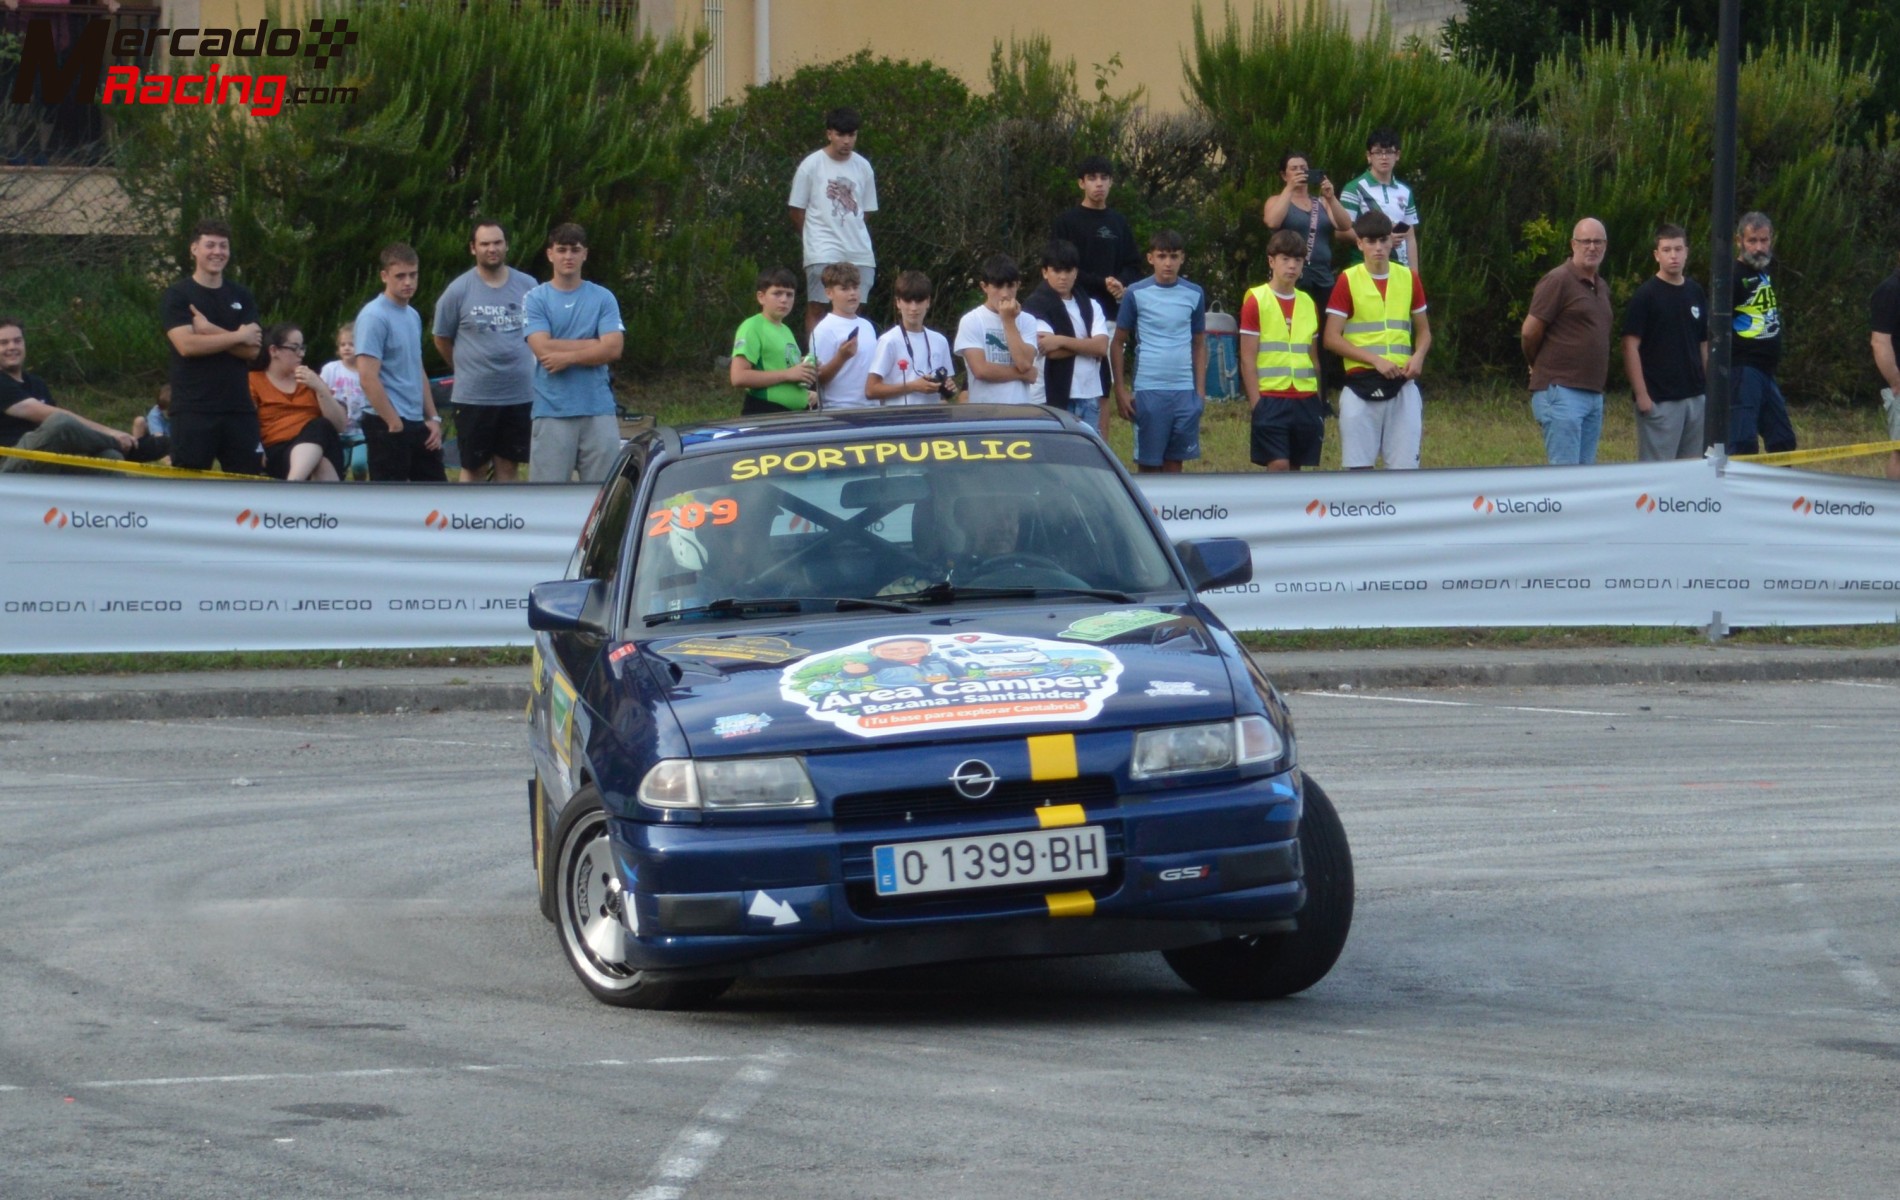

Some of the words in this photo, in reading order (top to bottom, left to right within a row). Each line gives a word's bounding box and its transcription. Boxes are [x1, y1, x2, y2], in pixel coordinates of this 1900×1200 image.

[730, 440, 1032, 480] SPORTPUBLIC
[1161, 504, 1228, 520] blendio
[1329, 501, 1396, 517] blendio
[1495, 498, 1562, 513] blendio
[1659, 497, 1722, 513] blendio
[1813, 500, 1875, 516] blendio
[72, 511, 148, 529] blendio
[264, 512, 339, 530] blendio
[451, 513, 525, 531] blendio
[648, 498, 738, 537] 209
[1275, 582, 1346, 593] OMODA
[1356, 579, 1428, 591] JAECOO
[1441, 579, 1511, 590] OMODA
[1520, 578, 1591, 590] JAECOO
[1604, 578, 1673, 589] OMODA
[1682, 578, 1750, 590] JAECOO
[1763, 579, 1829, 590] OMODA
[4, 600, 87, 612] OMODA
[99, 600, 183, 612] JAECOO
[198, 599, 280, 611] OMODA
[291, 599, 373, 611] JAECOO
[388, 599, 468, 611] OMODA
[479, 598, 529, 609] JAEC
[821, 684, 923, 711] Área
[932, 675, 1104, 696] Camper
[862, 697, 950, 715] Bezana
[964, 689, 1086, 704] Santander
[890, 712, 923, 726] base
[924, 710, 955, 723] para
[957, 705, 1012, 719] explorar
[882, 875, 892, 886] E
